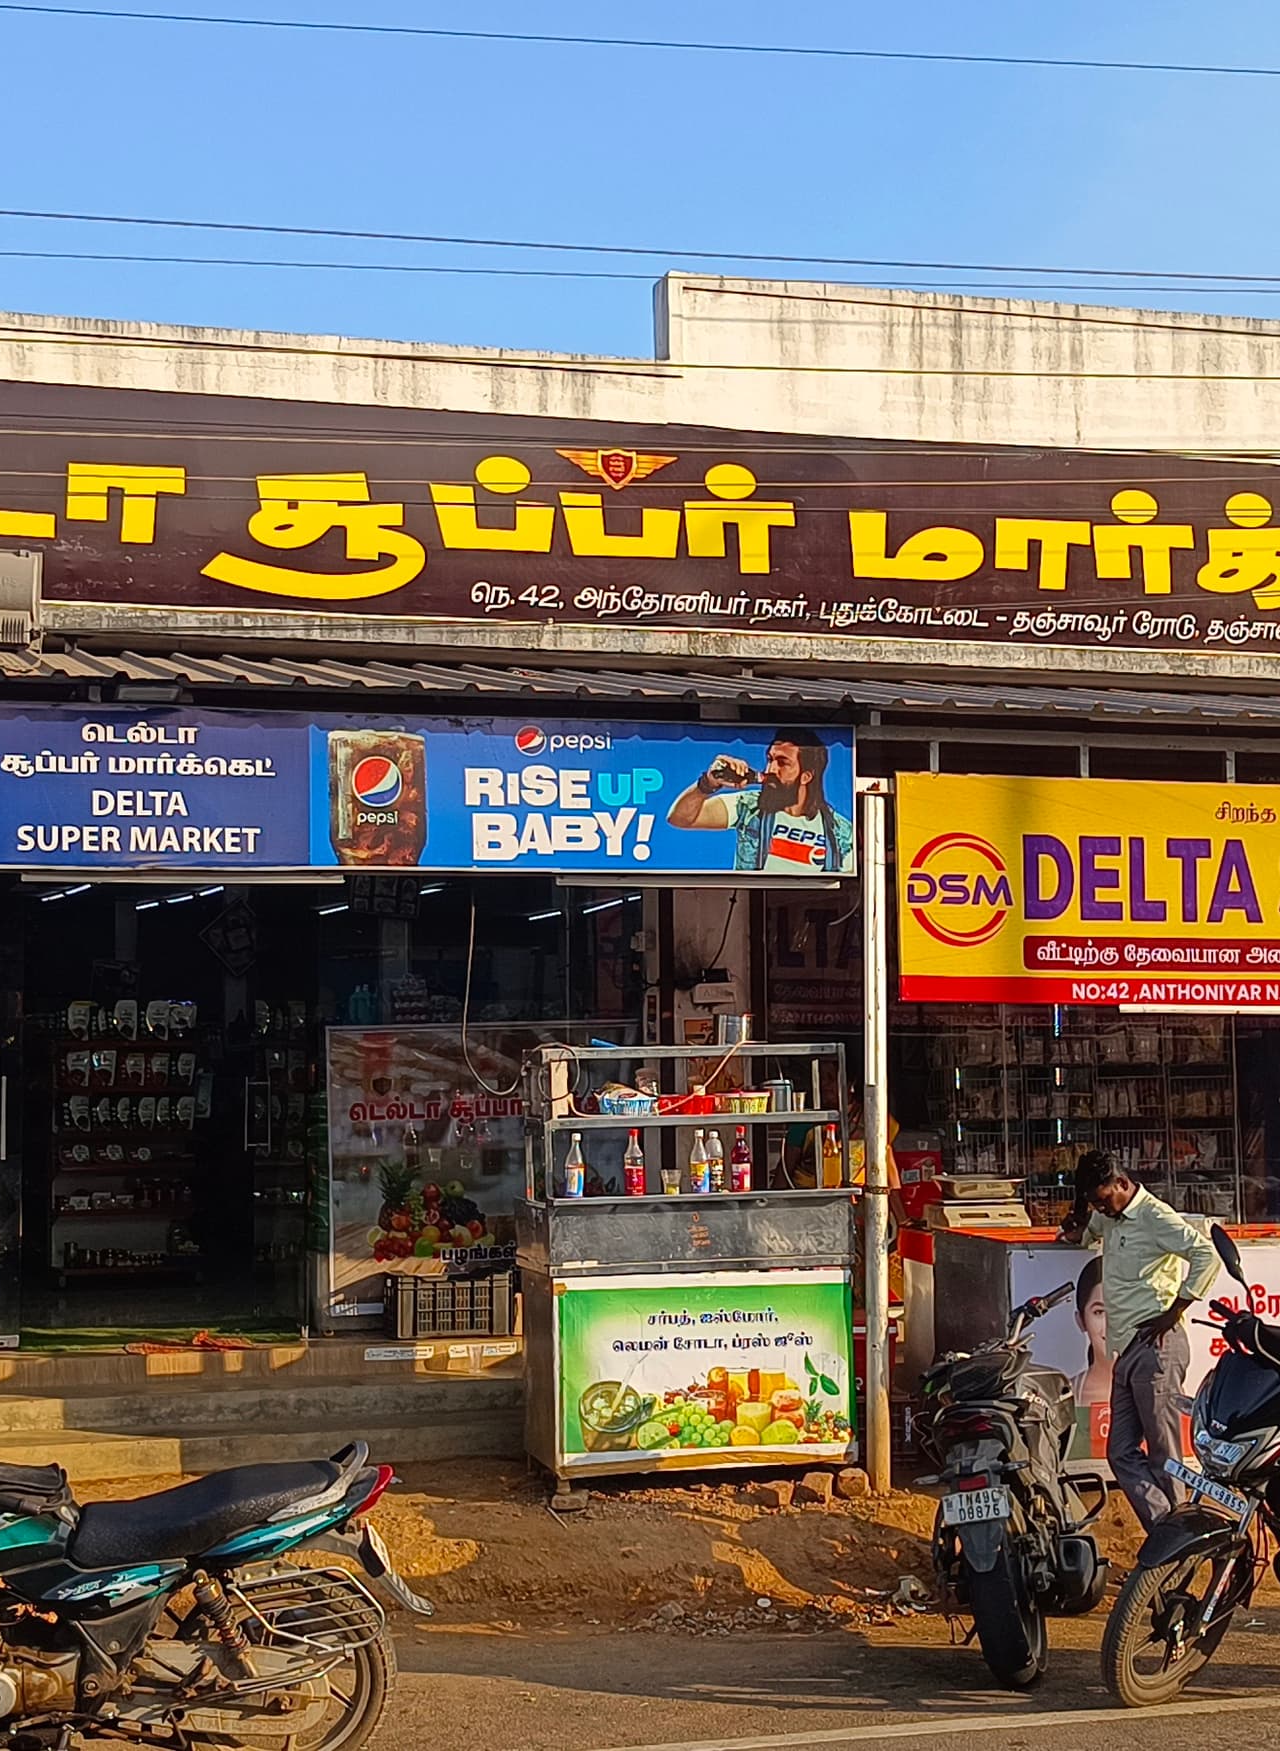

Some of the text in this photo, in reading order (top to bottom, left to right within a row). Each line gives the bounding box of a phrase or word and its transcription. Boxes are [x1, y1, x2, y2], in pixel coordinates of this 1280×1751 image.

[200, 455, 796, 600] சூப்பர்
[573, 585, 749, 618] அந்தோனியர்
[753, 592, 811, 622] நகர்,
[819, 596, 989, 629] புதுக்கோட்டை
[1009, 607, 1127, 643] தஞ்சாவூர்
[1132, 612, 1201, 641] ரோடு,
[81, 720, 199, 745] டெல்டா
[550, 729, 612, 753] pepsi
[0, 750, 276, 777] சூப்பர் மார்க்கெட்
[464, 764, 664, 810] RISE UP
[92, 789, 188, 817] DELTA
[1214, 802, 1276, 825] சிறந்த
[356, 810, 399, 827] pepsi
[17, 825, 261, 854] SUPER MARKET
[471, 807, 654, 862] BABY!
[771, 822, 827, 846] PEPS
[906, 872, 1013, 907] DSM
[1021, 832, 1264, 925] DELTA
[1036, 939, 1119, 967] வீட்டிற்கு
[1123, 943, 1240, 967] தேவையான
[1071, 982, 1130, 1000] NO:42
[349, 1095, 442, 1122] டெல்டா
[441, 1241, 517, 1264] பழங்கள்
